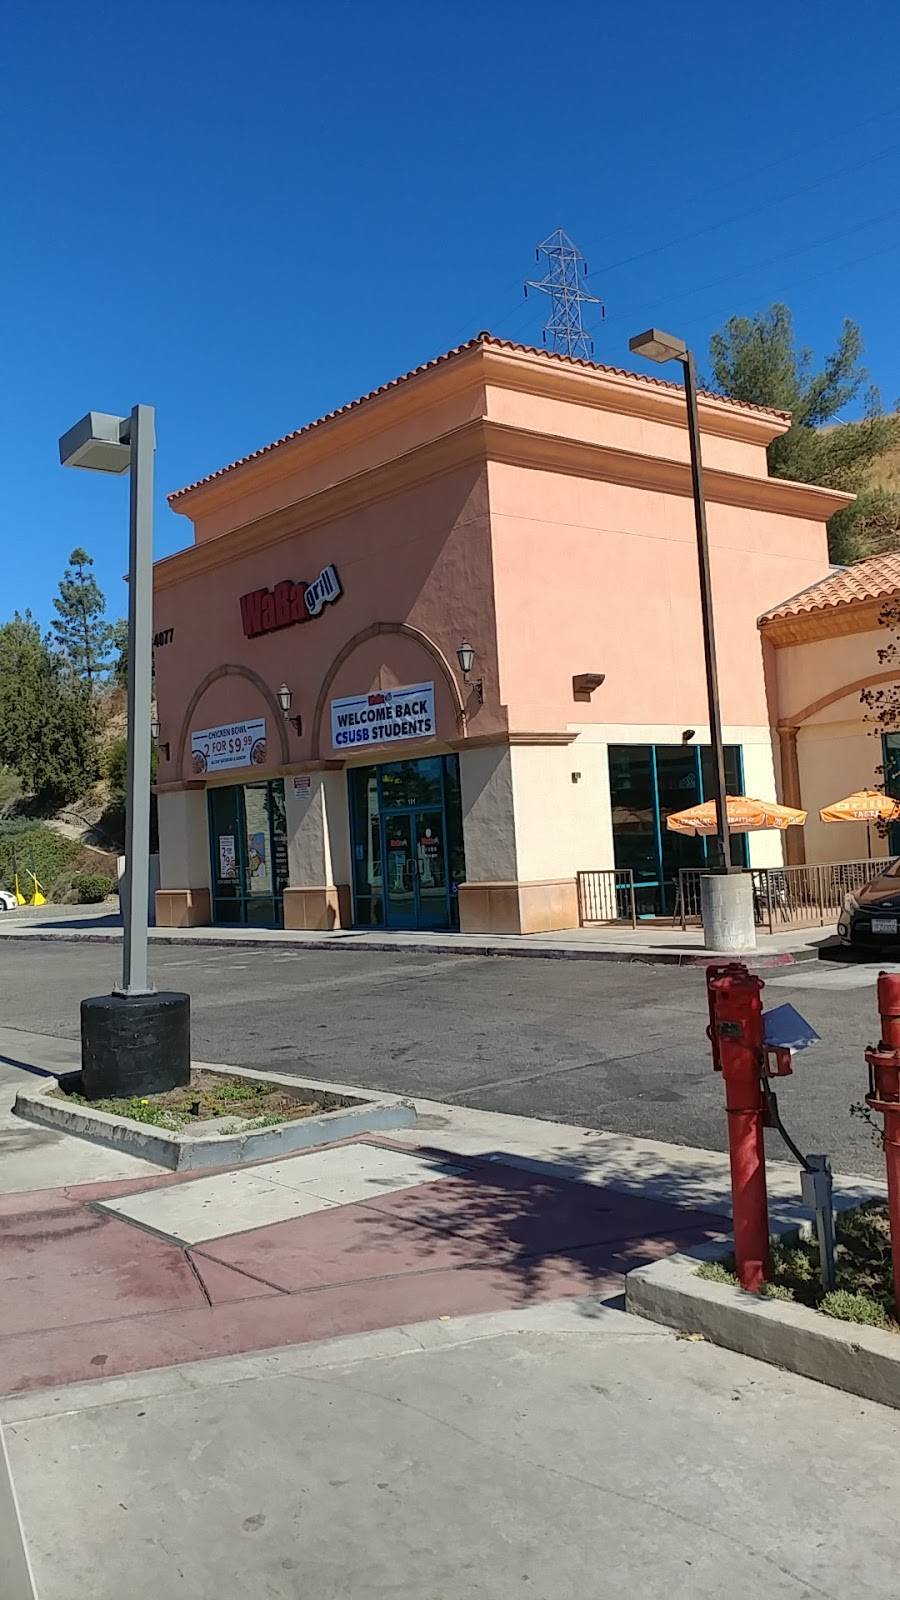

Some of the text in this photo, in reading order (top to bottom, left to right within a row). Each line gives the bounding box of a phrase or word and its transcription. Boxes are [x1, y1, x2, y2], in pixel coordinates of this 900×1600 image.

[305, 568, 336, 613] grill
[337, 706, 392, 727] WELCOME
[395, 700, 428, 718] BACK
[208, 728, 231, 740] CHICKEN
[335, 718, 431, 744] CSUSB STUDENTS
[204, 743, 210, 757] 2
[212, 741, 226, 753] FOR
